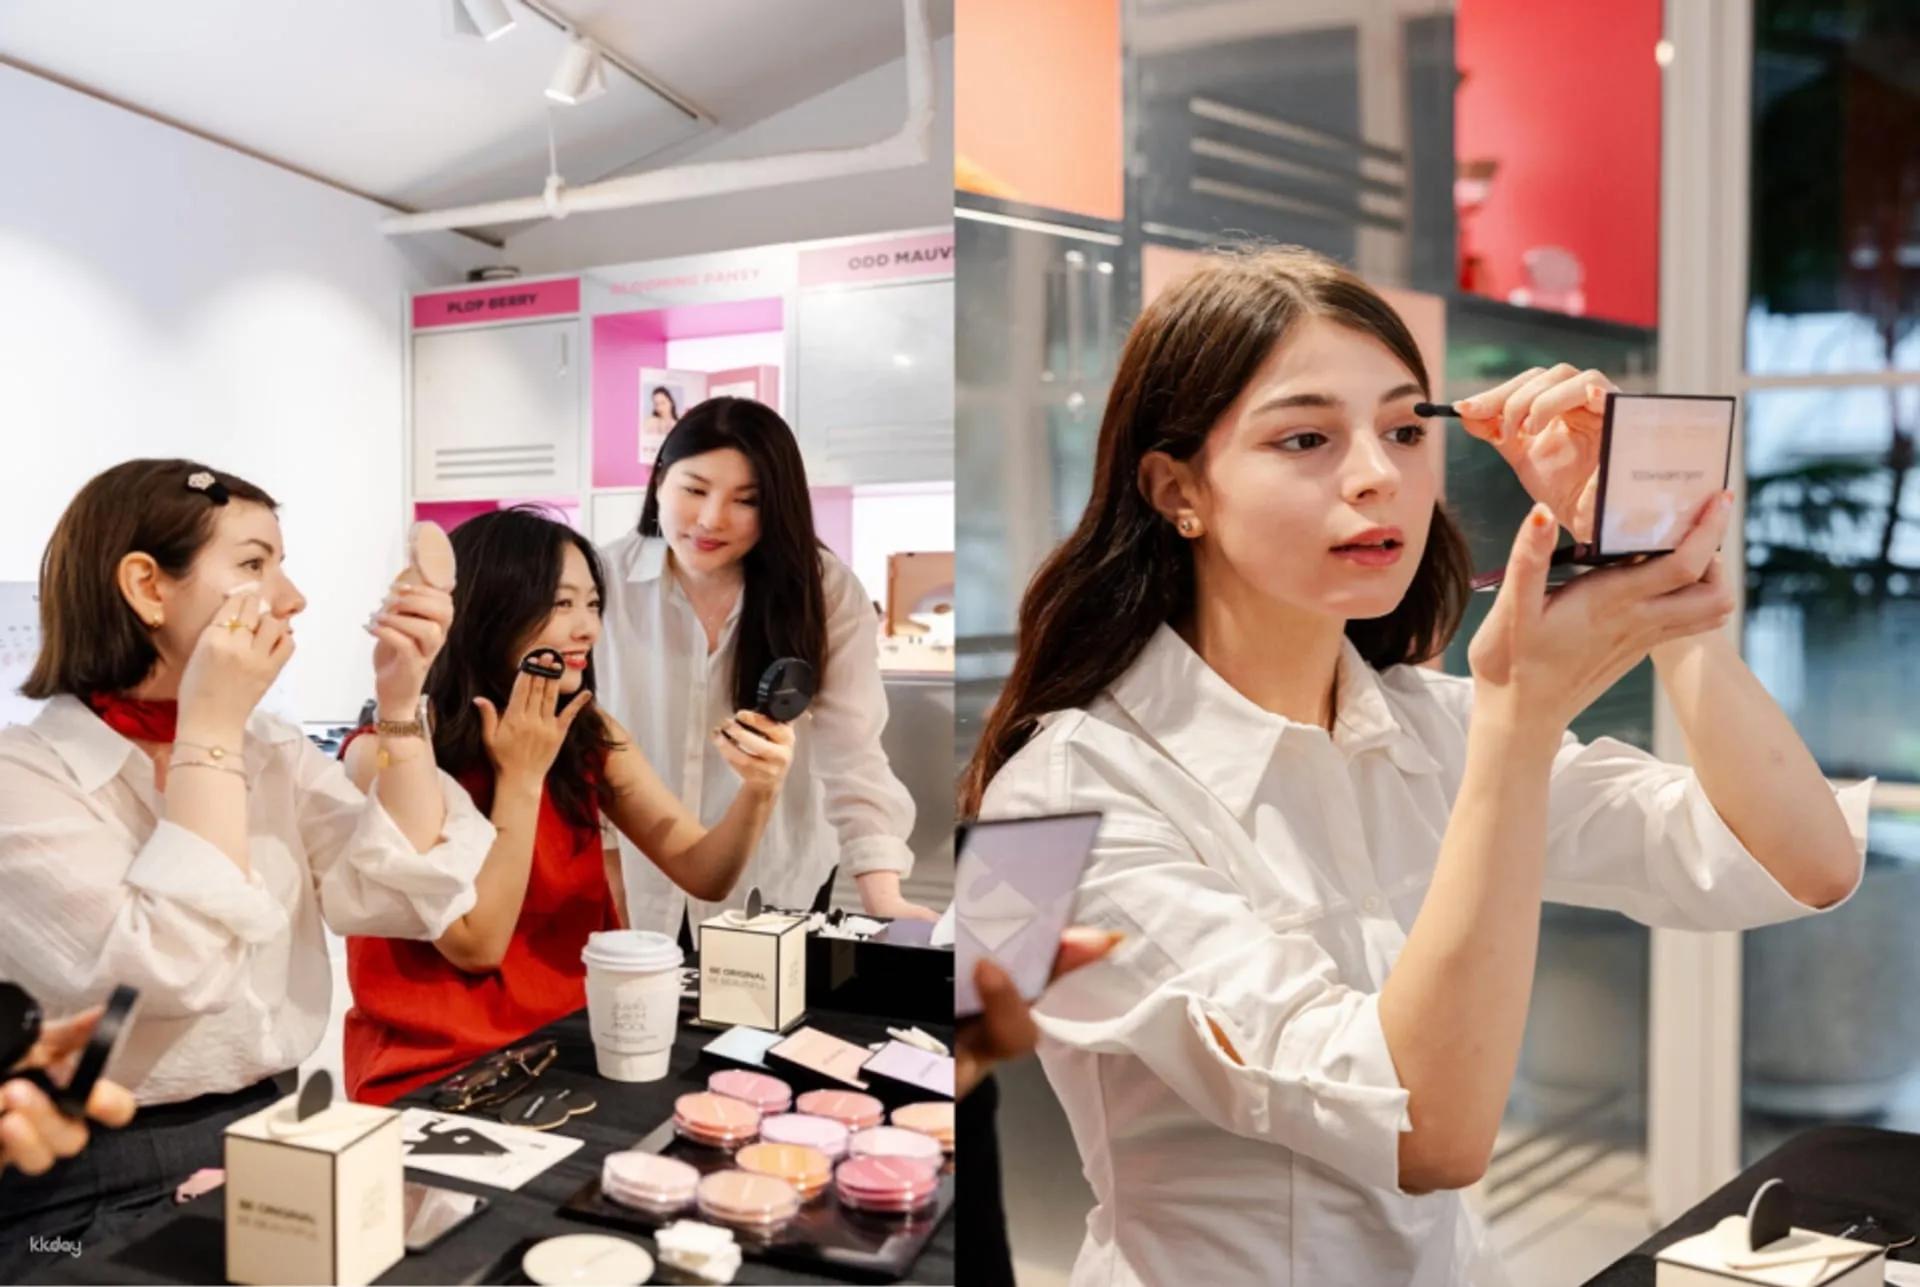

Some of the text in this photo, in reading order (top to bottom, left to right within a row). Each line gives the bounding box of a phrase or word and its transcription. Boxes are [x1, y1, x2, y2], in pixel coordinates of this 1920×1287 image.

[848, 246, 955, 270] ODD MAUV
[447, 293, 537, 314] PLOP BERRY
